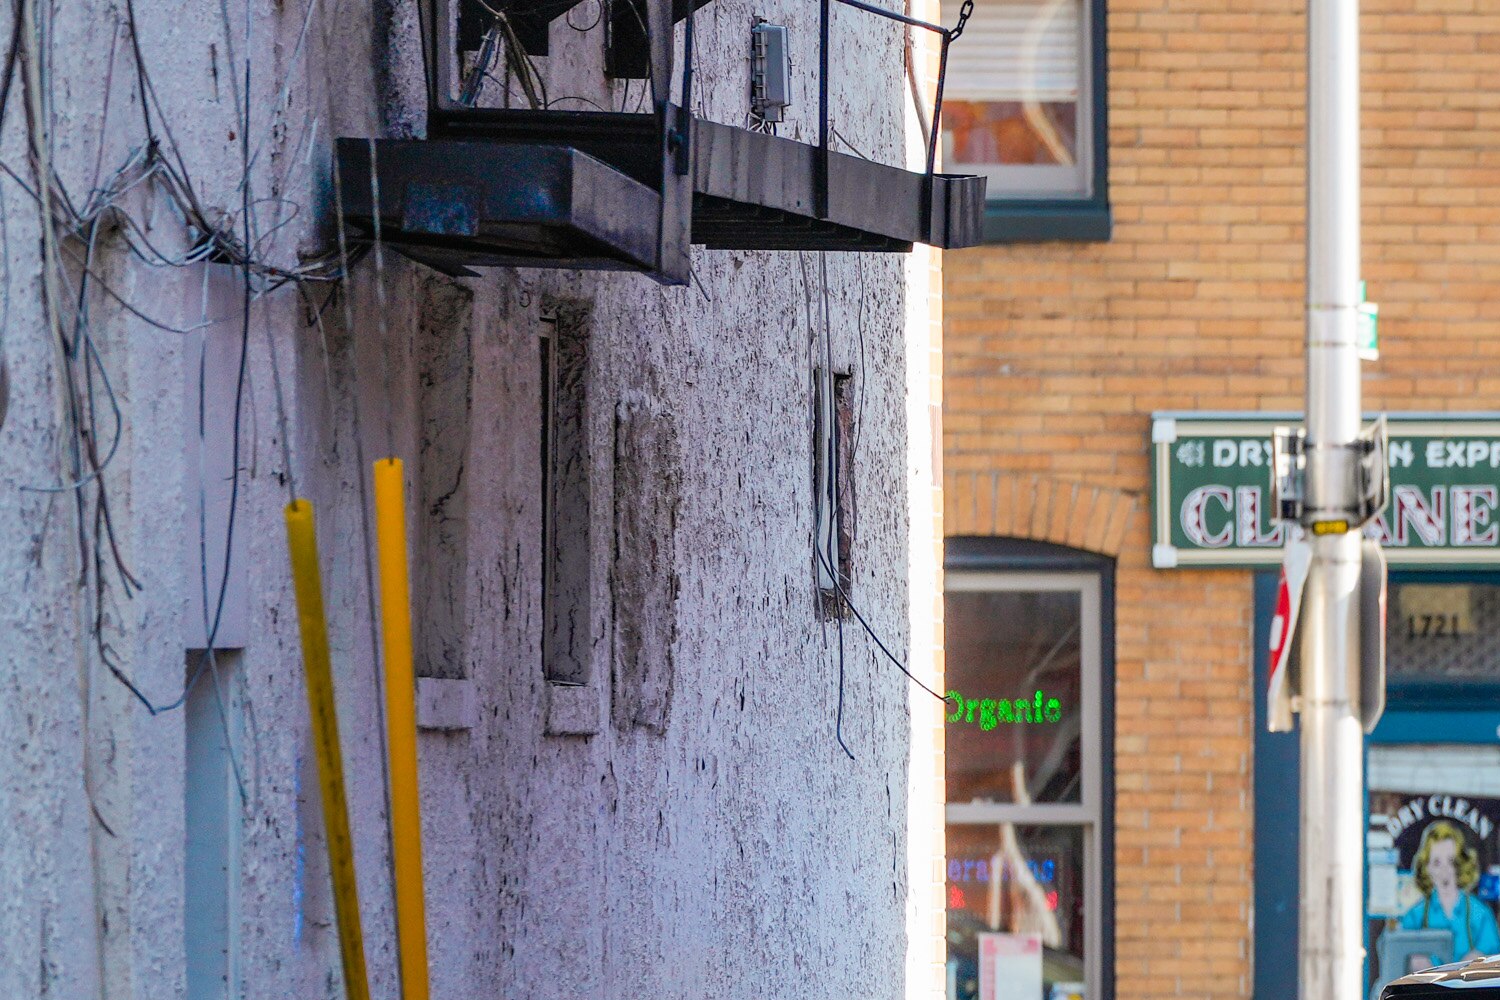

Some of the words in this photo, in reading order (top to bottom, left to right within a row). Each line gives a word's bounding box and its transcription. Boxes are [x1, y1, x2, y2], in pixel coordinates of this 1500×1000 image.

[1408, 614, 1459, 640] 1721
[1387, 797, 1424, 839] DRY
[1428, 794, 1494, 840] CLEAN
